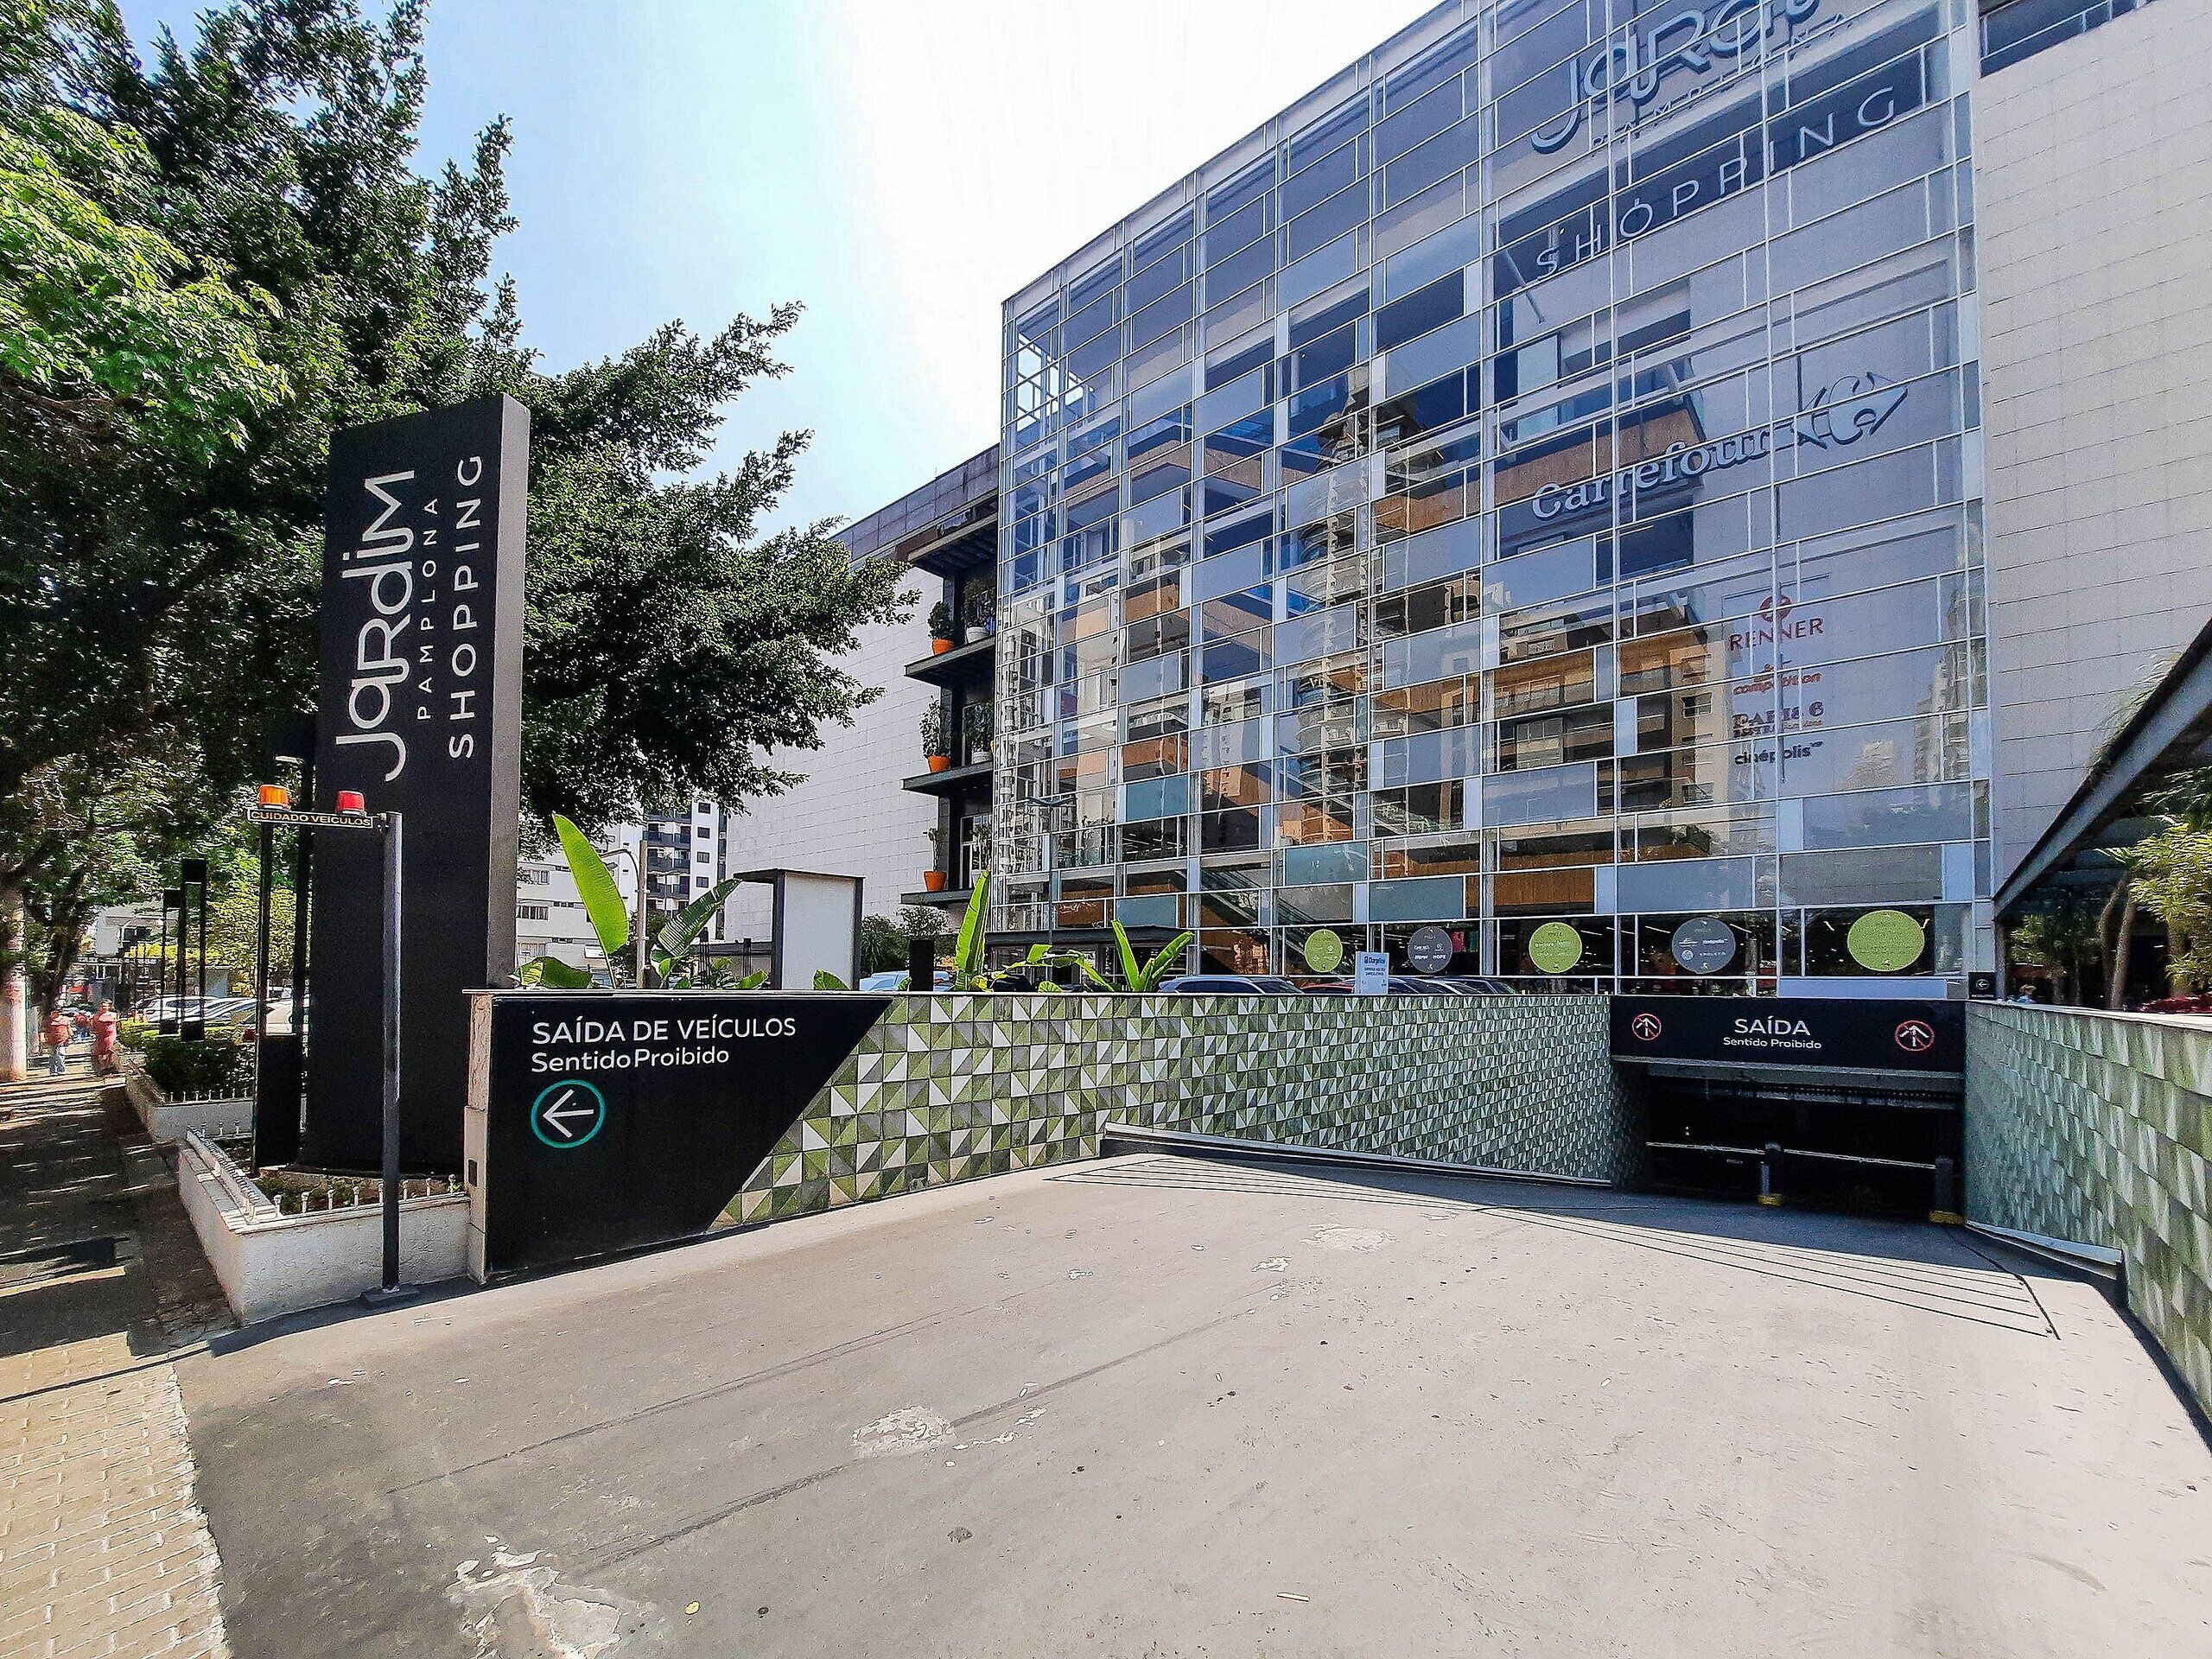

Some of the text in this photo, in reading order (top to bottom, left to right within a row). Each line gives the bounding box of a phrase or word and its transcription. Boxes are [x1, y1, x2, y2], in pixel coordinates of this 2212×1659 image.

[1535, 86, 1894, 276] SHOPPING
[1531, 428, 1770, 519] Carrefour
[416, 497, 439, 721] PAMPLONA
[448, 455, 483, 759] SHOPPING
[1729, 617, 1824, 652] RENNER
[1808, 701, 1824, 717] 6
[251, 811, 371, 826] CUIDADO VEICULOS
[531, 1013, 797, 1046] SAÍDA DE VEÍCULOS
[1734, 1015, 1811, 1036] SAÍDA
[531, 1046, 730, 1073] Sentido Proibido
[1723, 1037, 1822, 1049] Sentido Proibido
